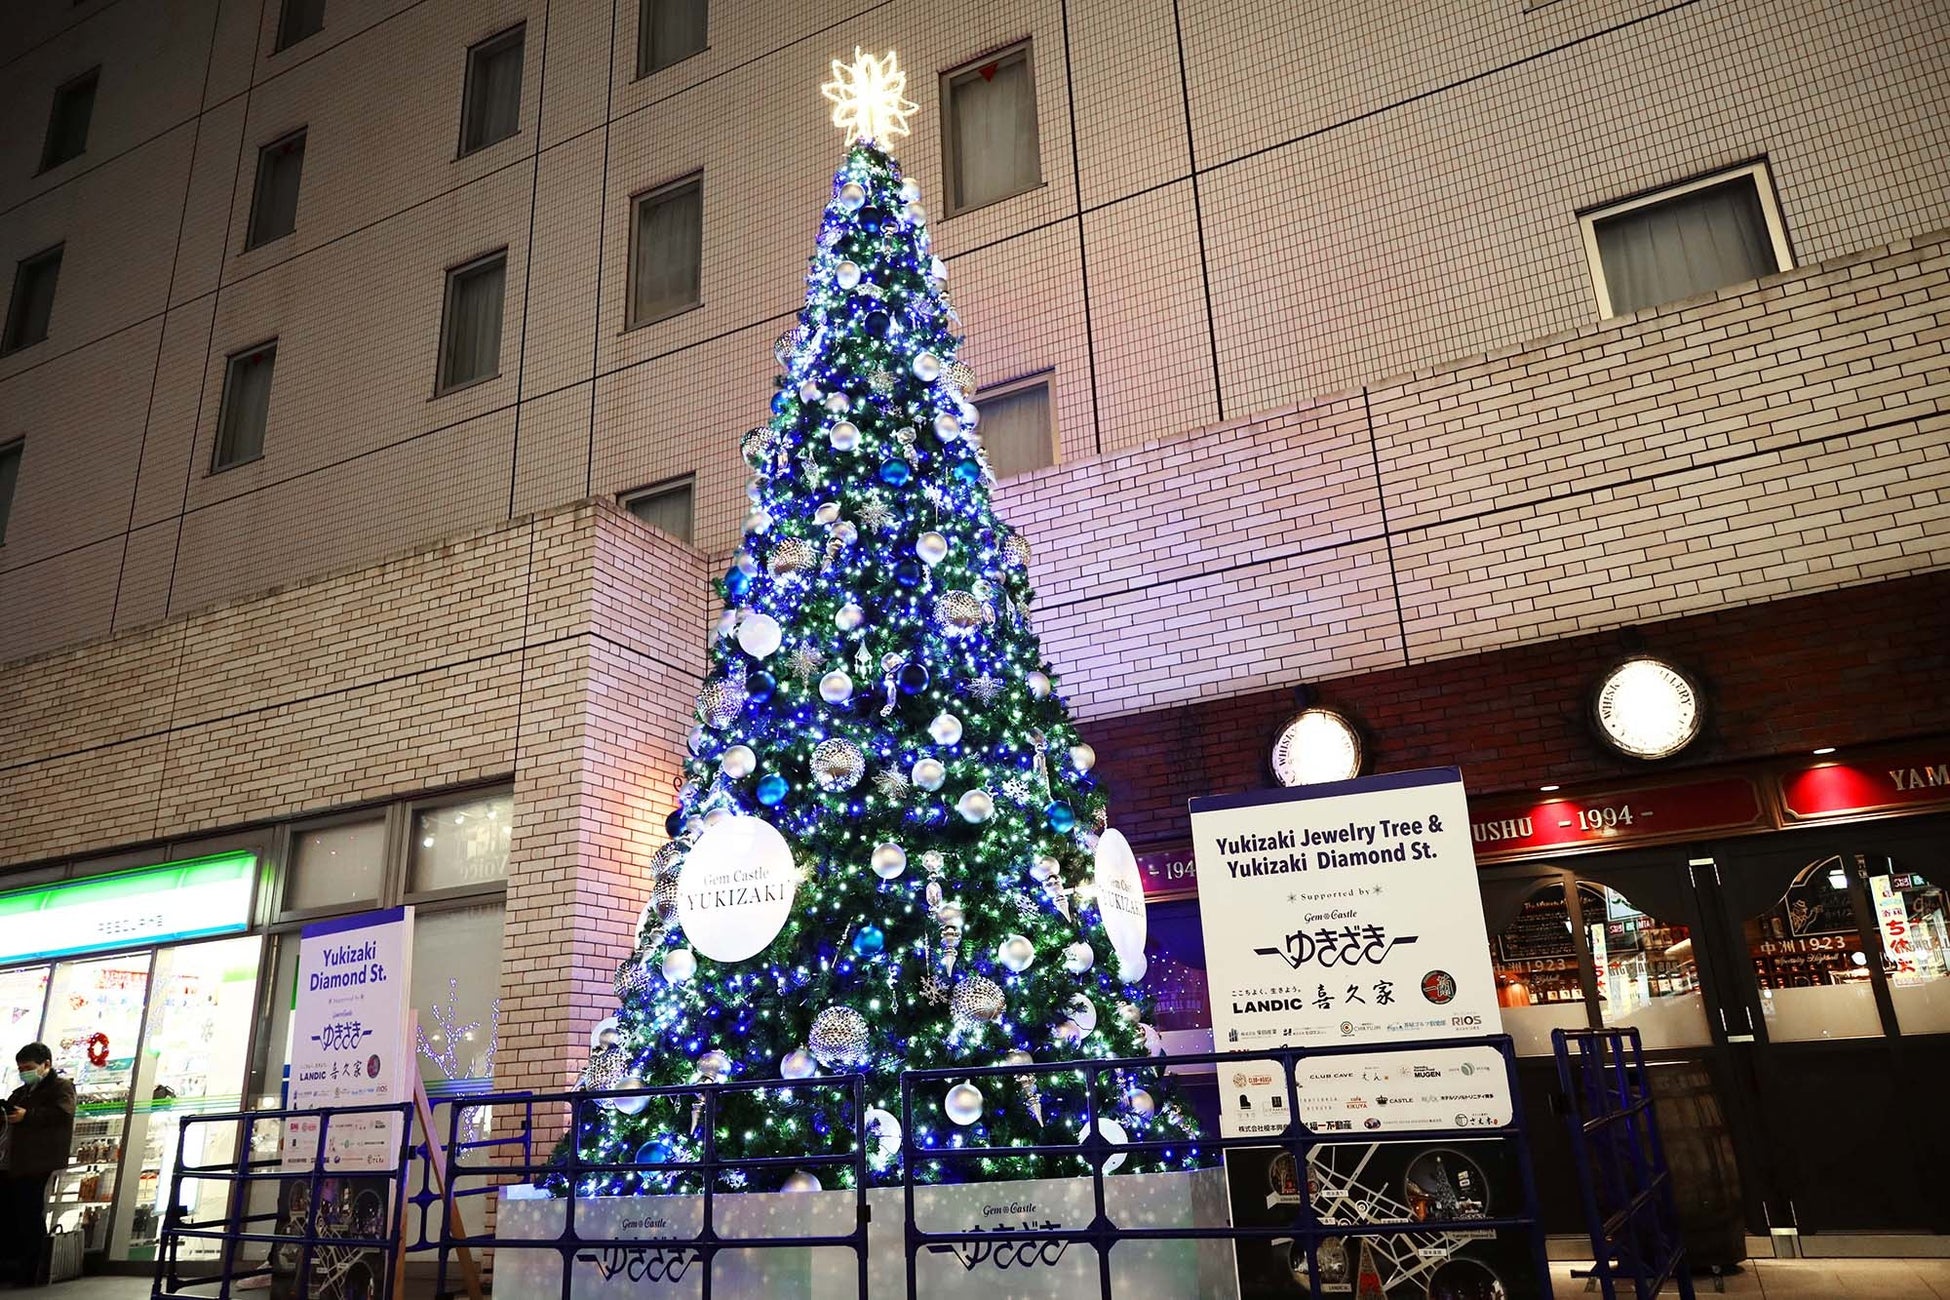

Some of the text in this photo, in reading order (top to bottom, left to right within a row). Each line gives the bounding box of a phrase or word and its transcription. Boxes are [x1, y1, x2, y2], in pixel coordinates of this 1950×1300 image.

[1889, 764, 1950, 791] YAM
[1216, 814, 1444, 856] Yukizaki Jewelry Tree &
[1227, 841, 1438, 878] Yukizaki Diamond St.
[704, 866, 770, 886] Gem Castle
[682, 884, 785, 910] YUKIZAKI
[1301, 888, 1370, 901] Supported by
[1304, 909, 1357, 924] Gem Castle
[323, 940, 376, 967] Yukizaki
[1283, 924, 1389, 969] ゆきざき
[310, 963, 387, 991] Diamond St.
[1312, 979, 1396, 1010] 喜久家
[1232, 998, 1303, 1014] LANDIC
[1451, 1015, 1482, 1027] RIOS
[322, 1020, 362, 1051] ゆきざき
[299, 1071, 326, 1082] LANDIC
[1309, 1072, 1332, 1080] CLUB
[1414, 1070, 1441, 1079] MUGEN
[983, 1201, 1037, 1218] Gem Castle
[622, 1216, 668, 1231] Gem Castle
